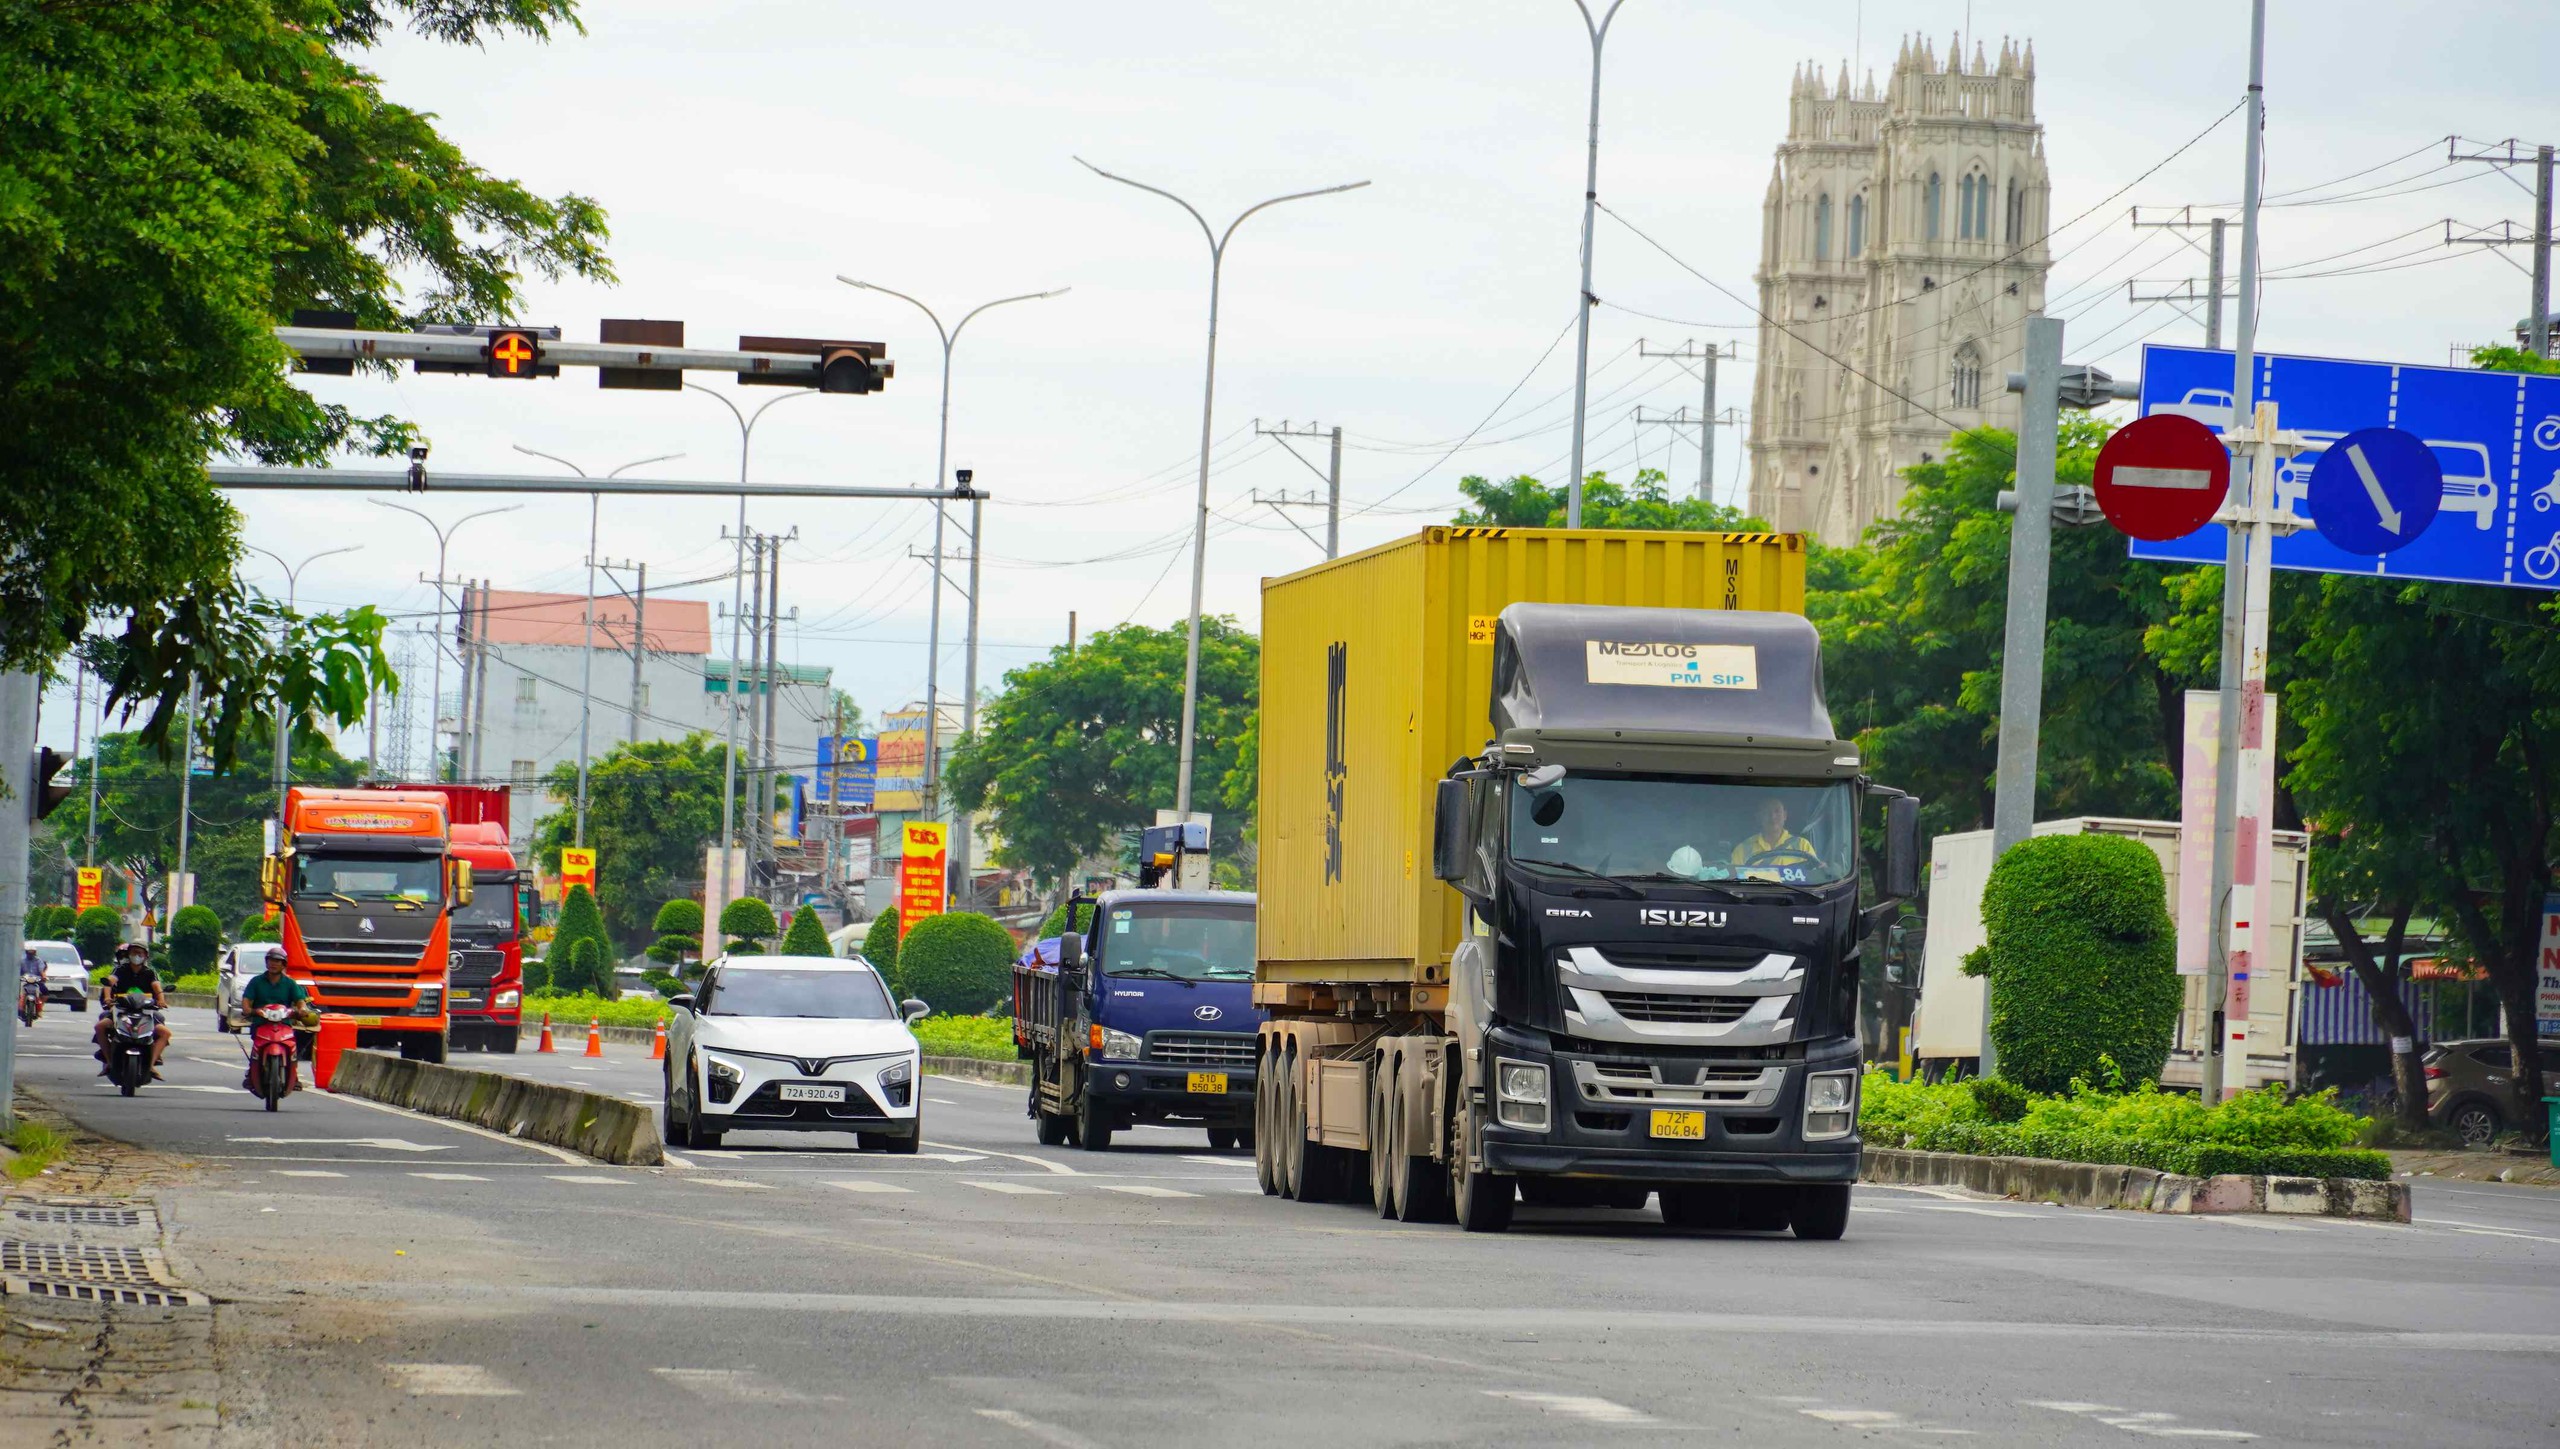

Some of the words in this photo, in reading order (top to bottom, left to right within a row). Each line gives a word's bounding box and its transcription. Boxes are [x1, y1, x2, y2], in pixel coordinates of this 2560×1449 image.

[1671, 673, 1701, 684] PM
[1712, 675, 1744, 685] SIP
[1546, 908, 1593, 918] GIGA
[1640, 909, 1727, 928] ISUZU
[1199, 1074, 1216, 1083] 51D
[787, 1088, 840, 1099] 72A-920.49
[1192, 1083, 1222, 1092] 550.38
[1667, 1112, 1690, 1124] 72F
[1656, 1124, 1698, 1137] 004.84
